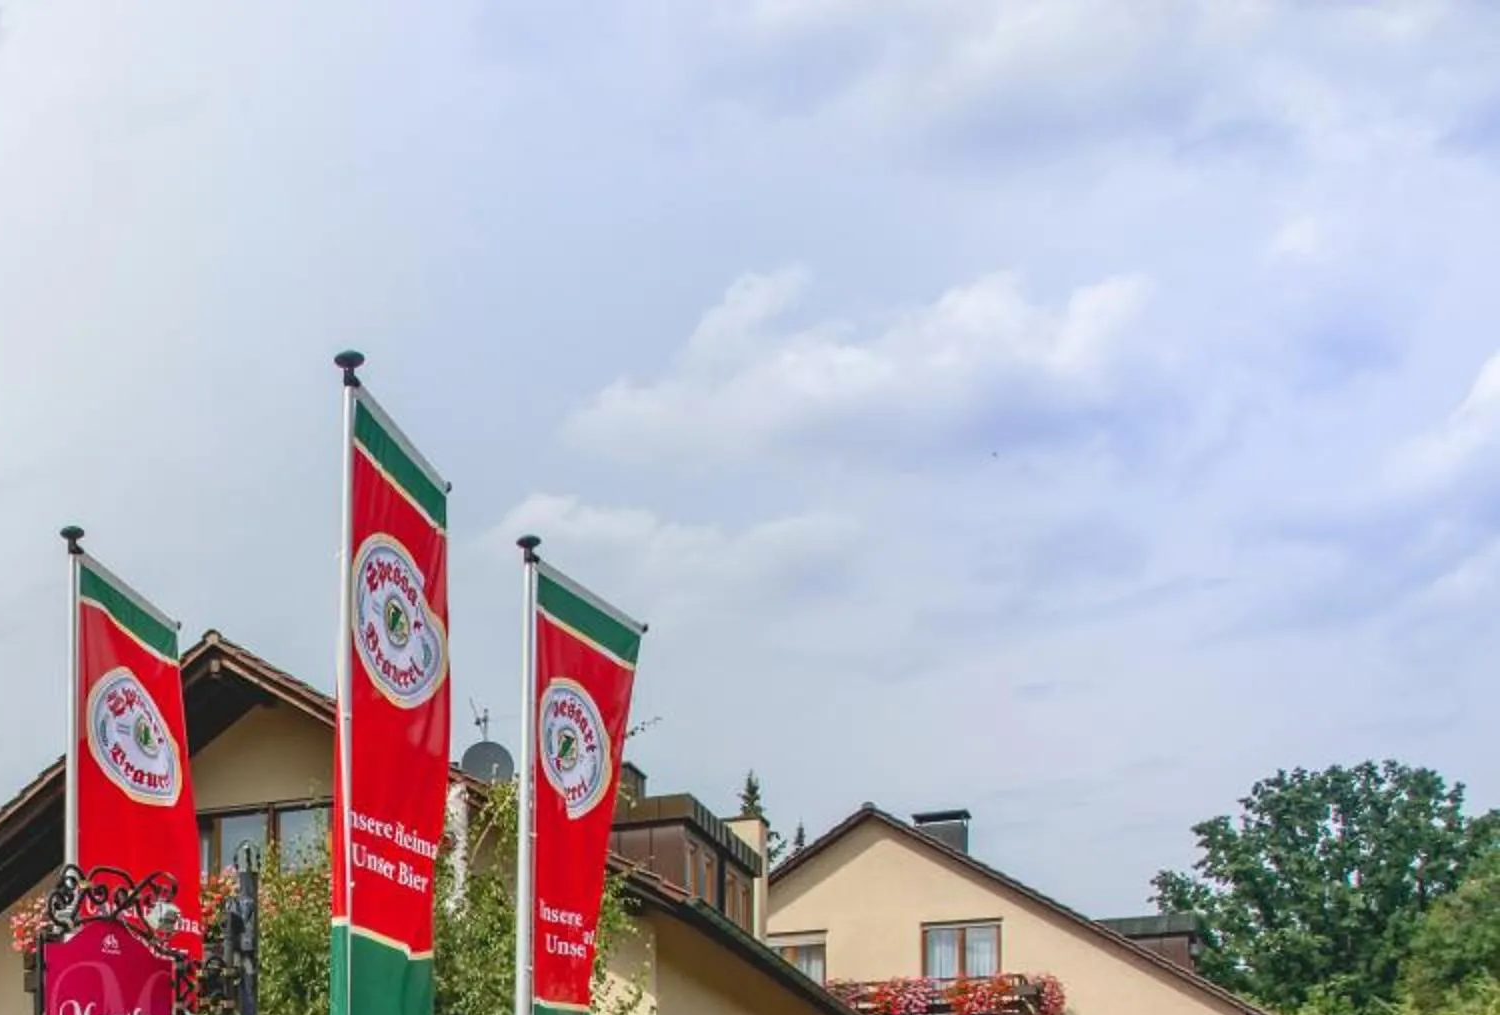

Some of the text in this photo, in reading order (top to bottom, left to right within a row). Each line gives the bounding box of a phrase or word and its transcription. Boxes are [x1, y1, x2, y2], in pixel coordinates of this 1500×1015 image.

[348, 810, 394, 839] nsere
[352, 842, 430, 894] Unser Bier
